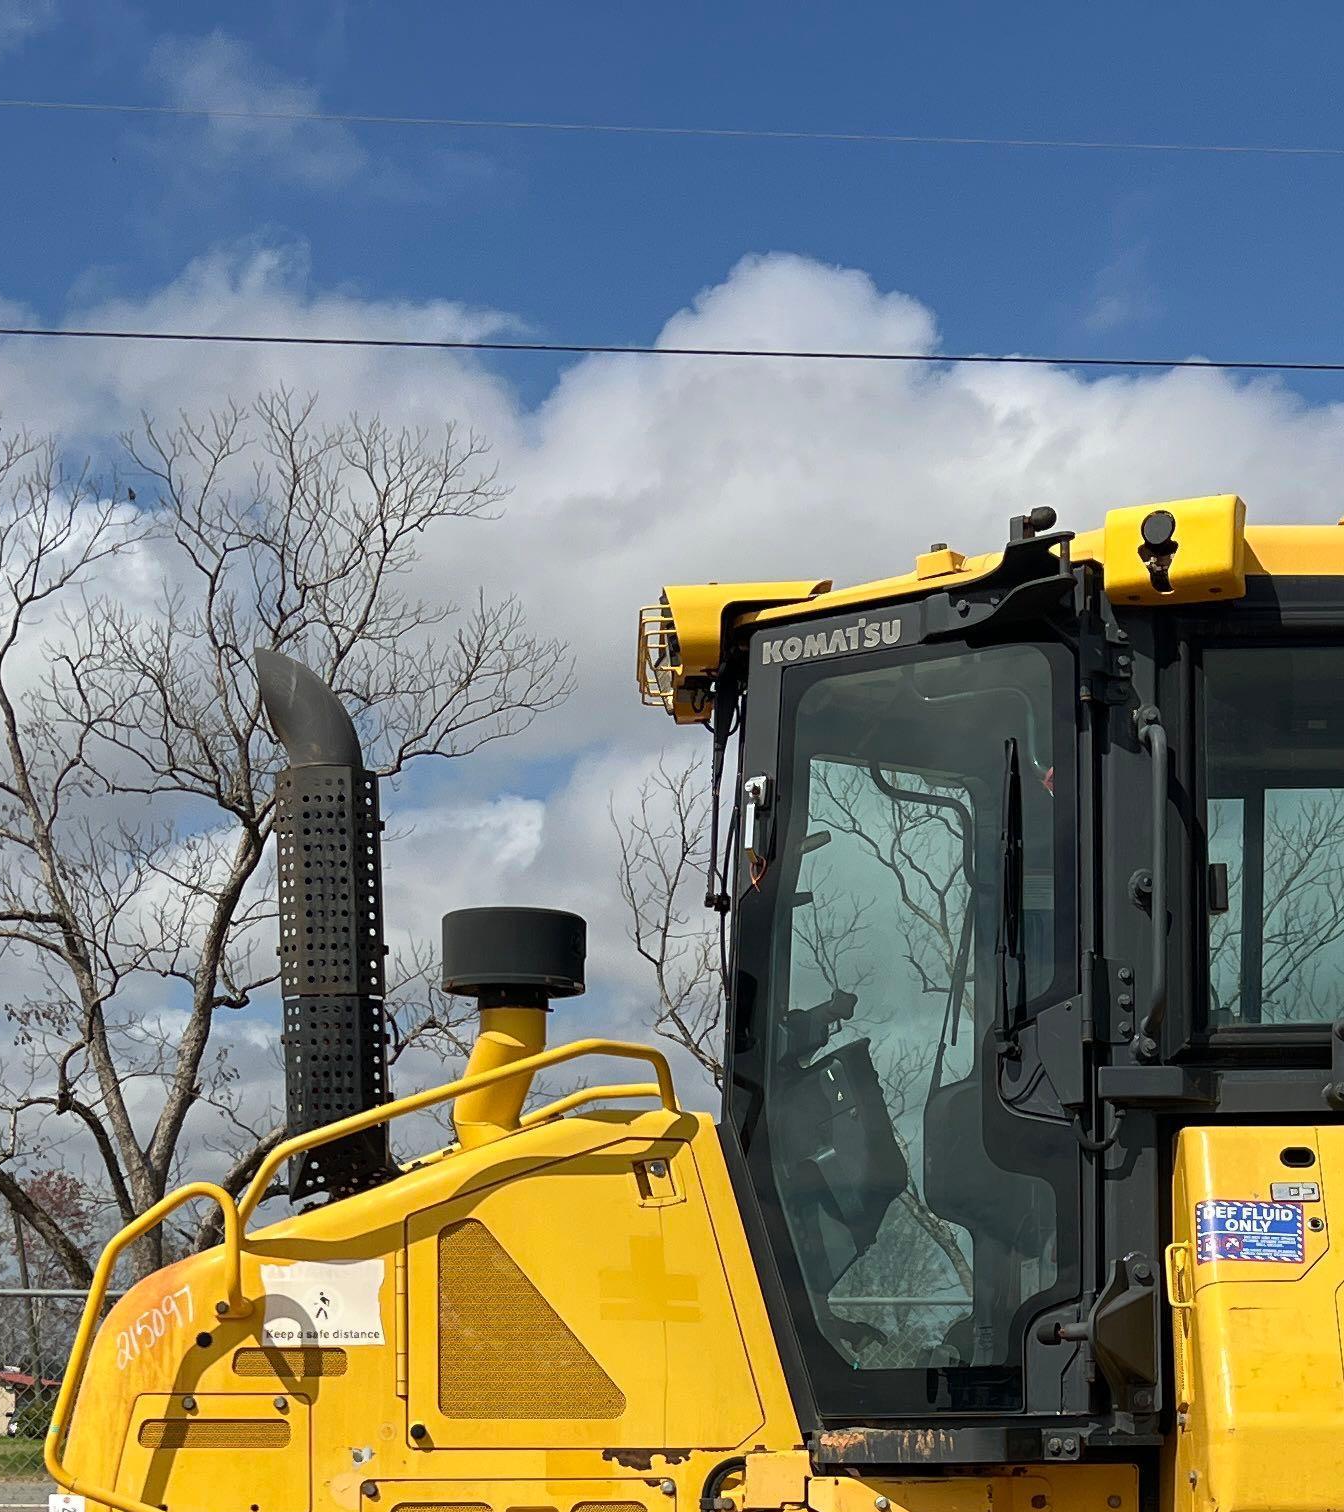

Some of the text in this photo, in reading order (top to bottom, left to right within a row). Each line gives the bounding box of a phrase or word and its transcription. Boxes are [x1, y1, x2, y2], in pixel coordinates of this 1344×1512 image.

[762, 618, 902, 665] KOMATSU
[1203, 1206, 1293, 1221] DEF FLUID
[1225, 1218, 1271, 1232] ONLY
[116, 1284, 194, 1370] 215097
[266, 1329, 380, 1340] Keep a safe distance
